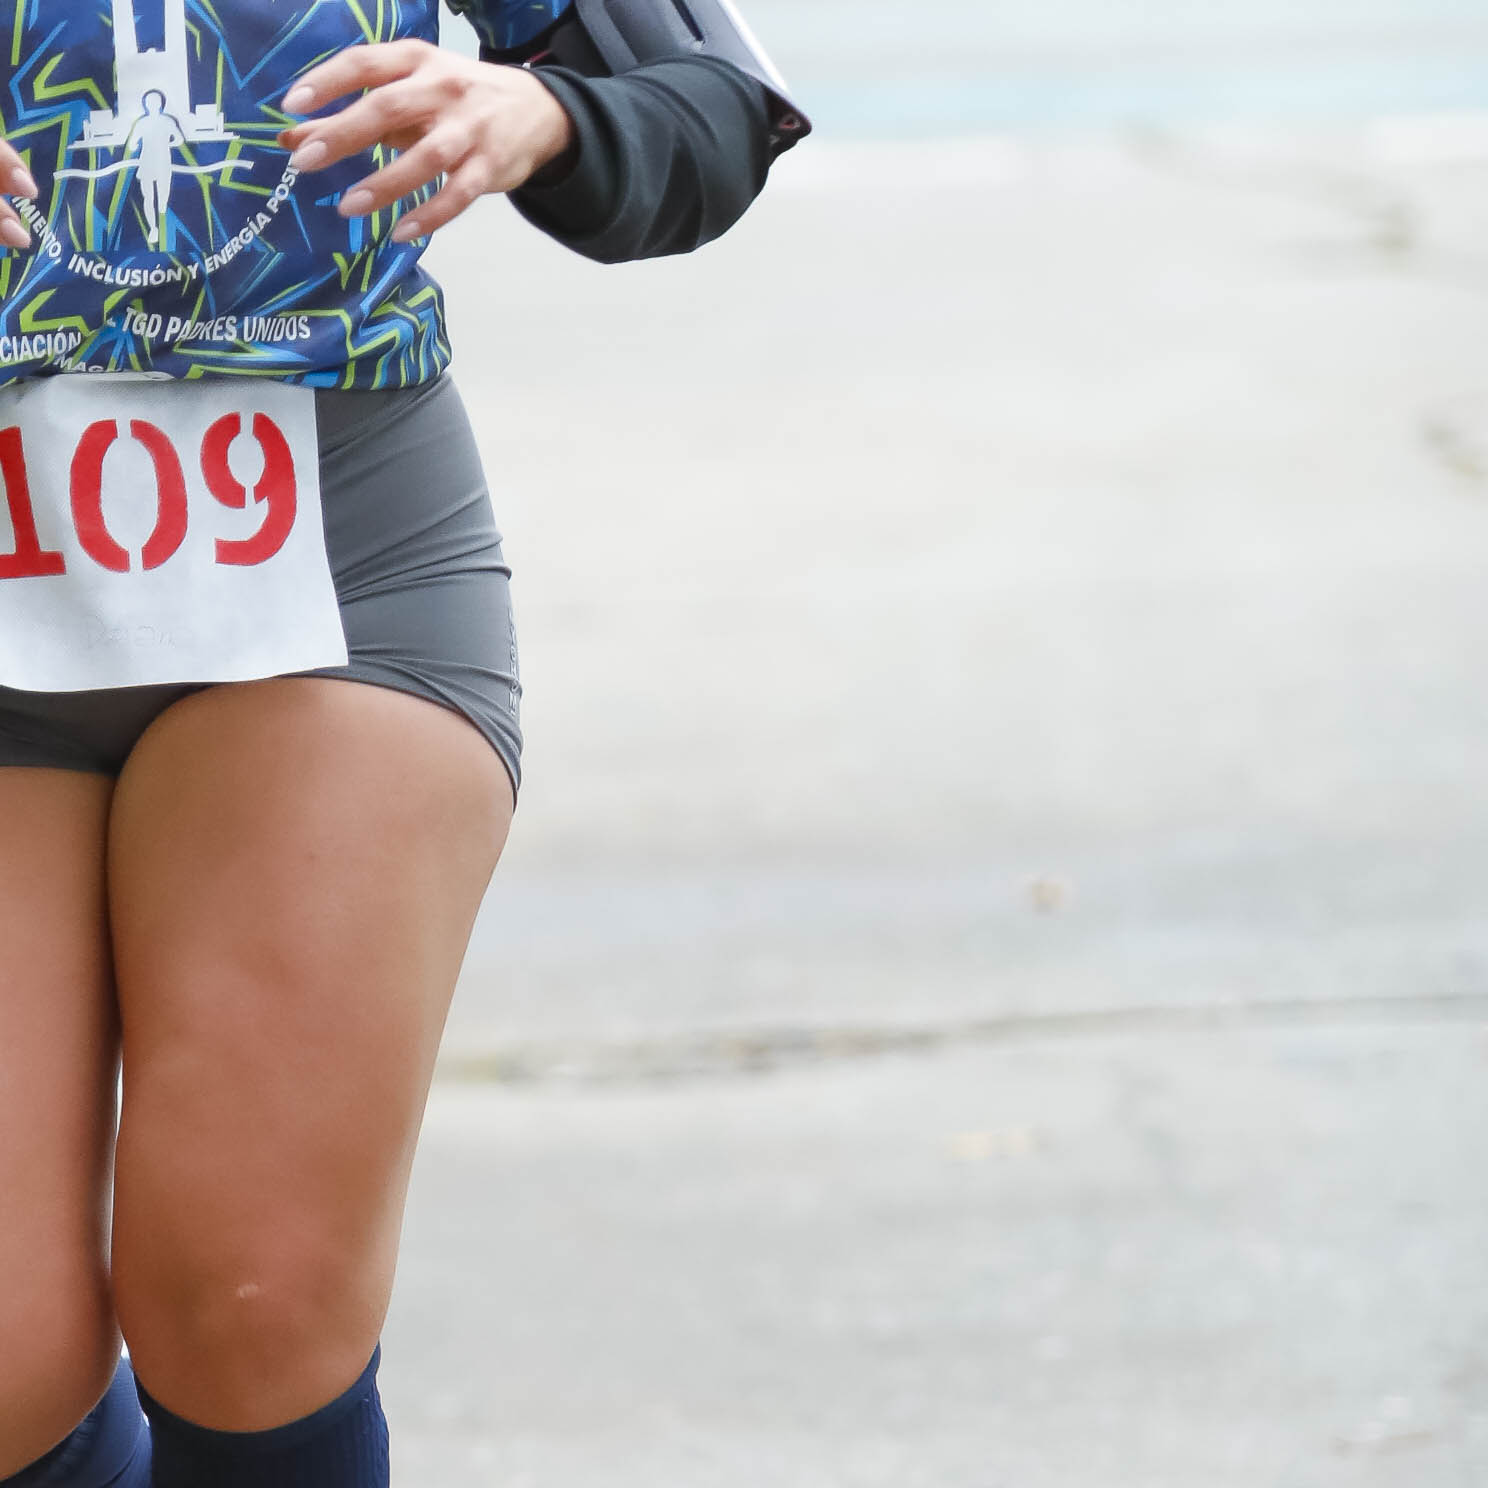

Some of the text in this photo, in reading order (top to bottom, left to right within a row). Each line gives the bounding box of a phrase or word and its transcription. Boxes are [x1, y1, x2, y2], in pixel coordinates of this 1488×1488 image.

[68, 253, 182, 286] INCLUSIÓN
[187, 262, 199, 280] Y
[204, 212, 272, 274] ENERGÍA
[122, 306, 163, 338] TGD
[163, 315, 237, 343] PADRES
[243, 315, 311, 342] UNIDOS
